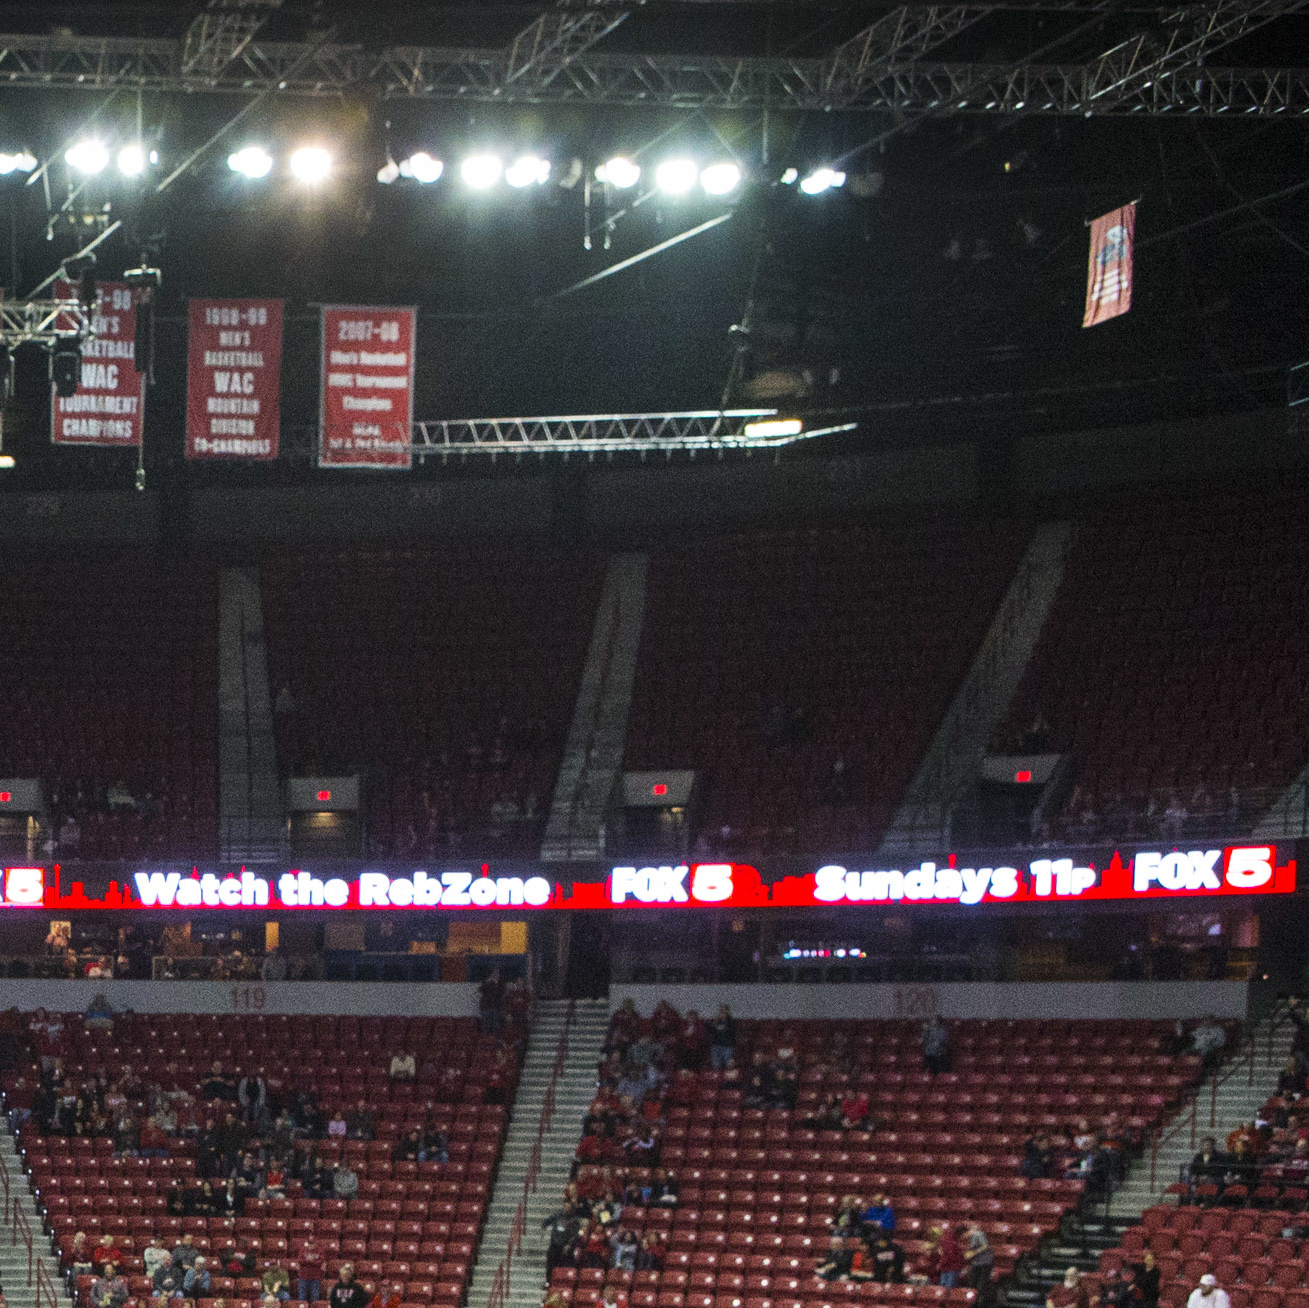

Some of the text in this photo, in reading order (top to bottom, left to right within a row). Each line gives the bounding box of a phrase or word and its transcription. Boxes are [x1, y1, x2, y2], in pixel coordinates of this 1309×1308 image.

[214, 371, 254, 393] WAC
[6, 868, 43, 903] 5
[611, 864, 733, 902] FOX 5
[813, 862, 1017, 903] Sundays
[1134, 847, 1274, 891] FOX 5
[135, 871, 551, 905] Watch the RebZone
[230, 984, 267, 1009] 119
